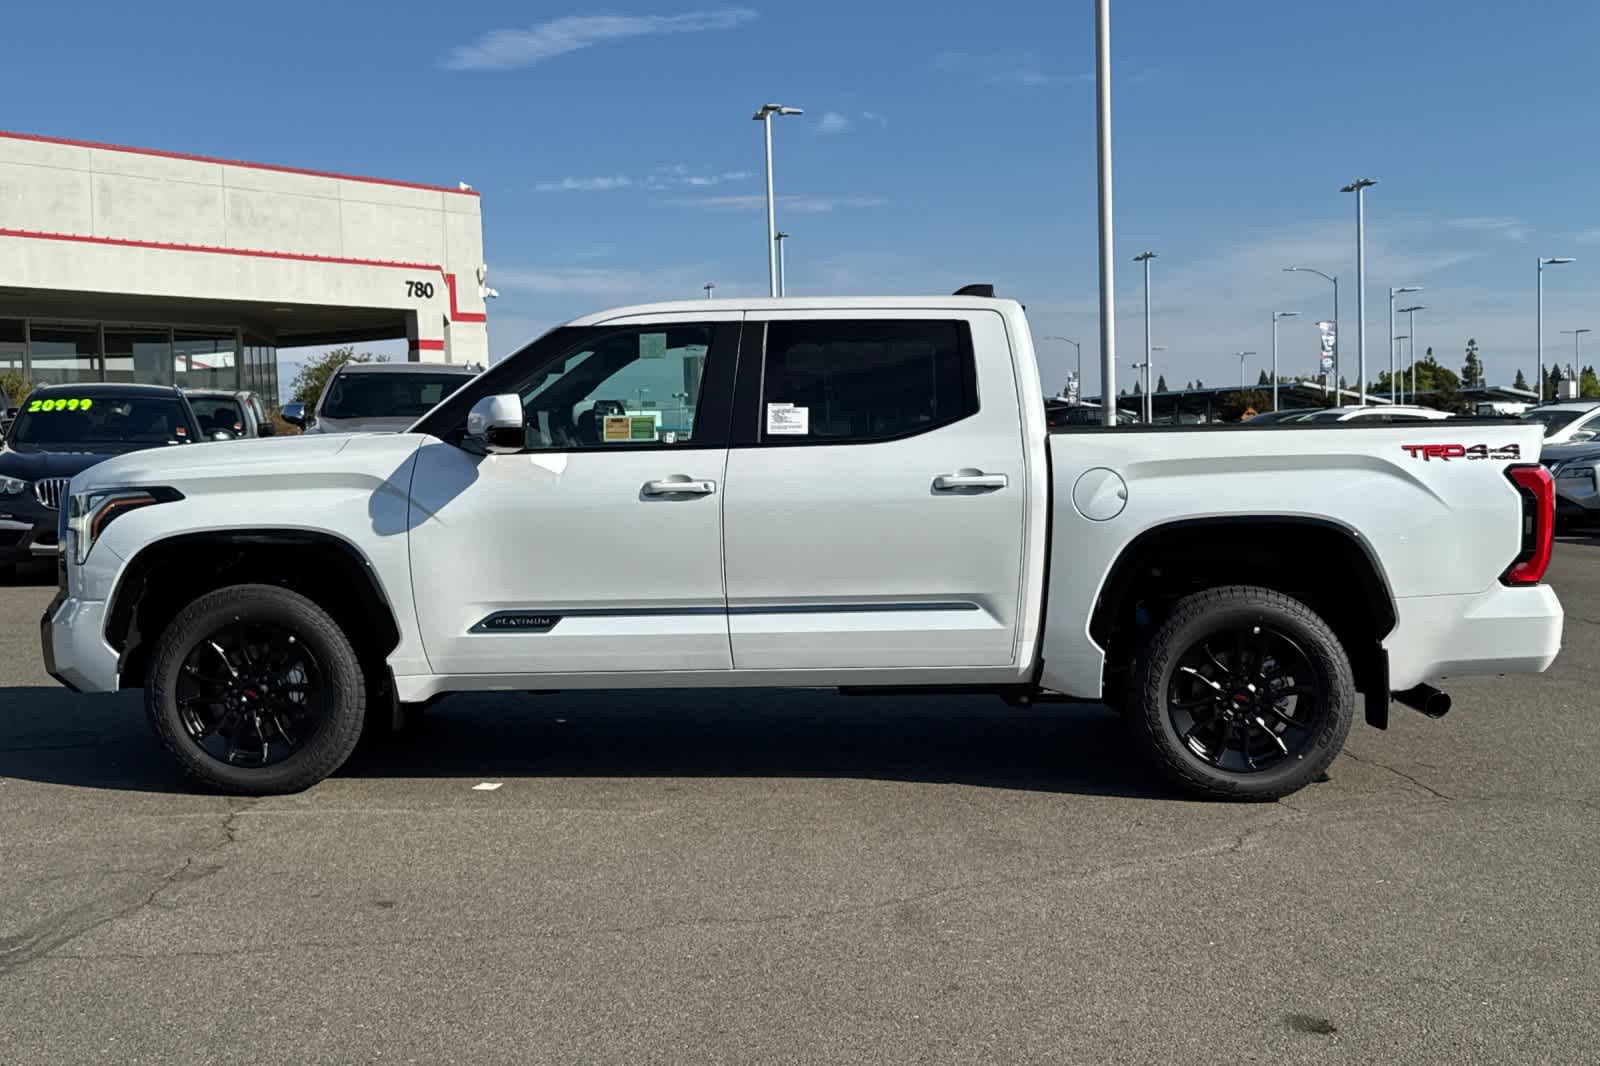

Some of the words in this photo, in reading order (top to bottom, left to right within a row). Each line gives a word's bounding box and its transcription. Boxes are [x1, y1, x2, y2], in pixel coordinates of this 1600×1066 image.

[405, 280, 434, 299] 780
[28, 398, 92, 412] 20999
[1401, 444, 1466, 461] TRD
[495, 617, 550, 625] PLATINUM
